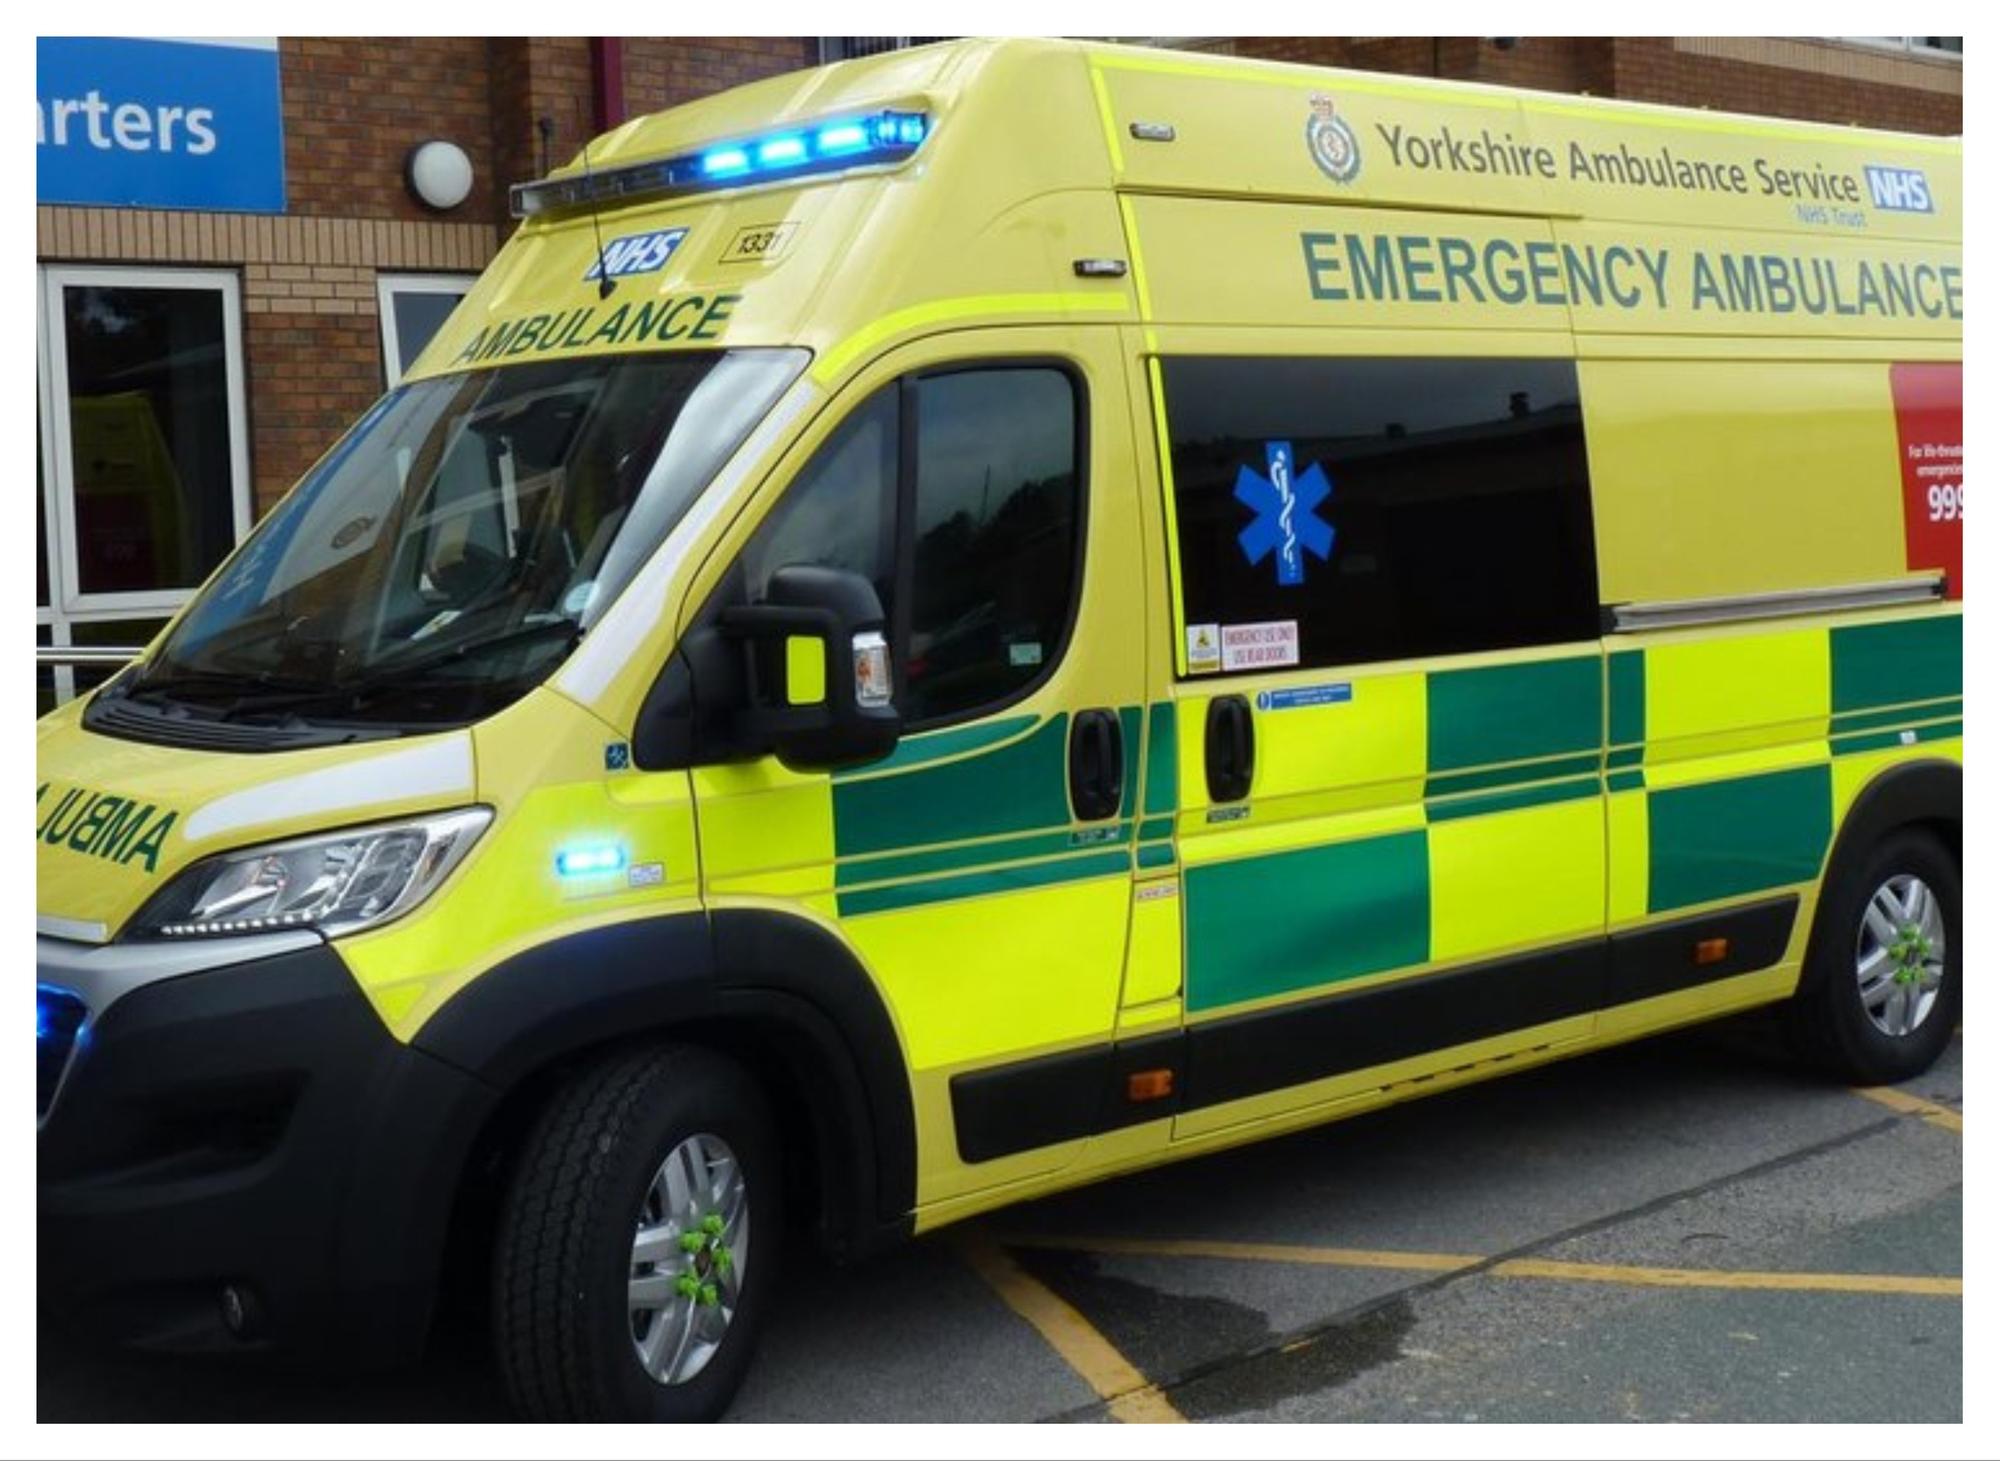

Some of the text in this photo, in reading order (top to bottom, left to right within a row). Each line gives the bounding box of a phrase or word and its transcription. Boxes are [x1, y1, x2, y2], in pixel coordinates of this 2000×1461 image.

[1376, 123, 1860, 203] Yorkshire Ambulance Service
[1867, 169, 1930, 209] NHS
[1796, 204, 1868, 229] NHS Trust
[588, 231, 683, 278] NHS
[1300, 232, 1963, 320] EMERGENCY AMBULANCE
[452, 295, 743, 364] AMBULANCE
